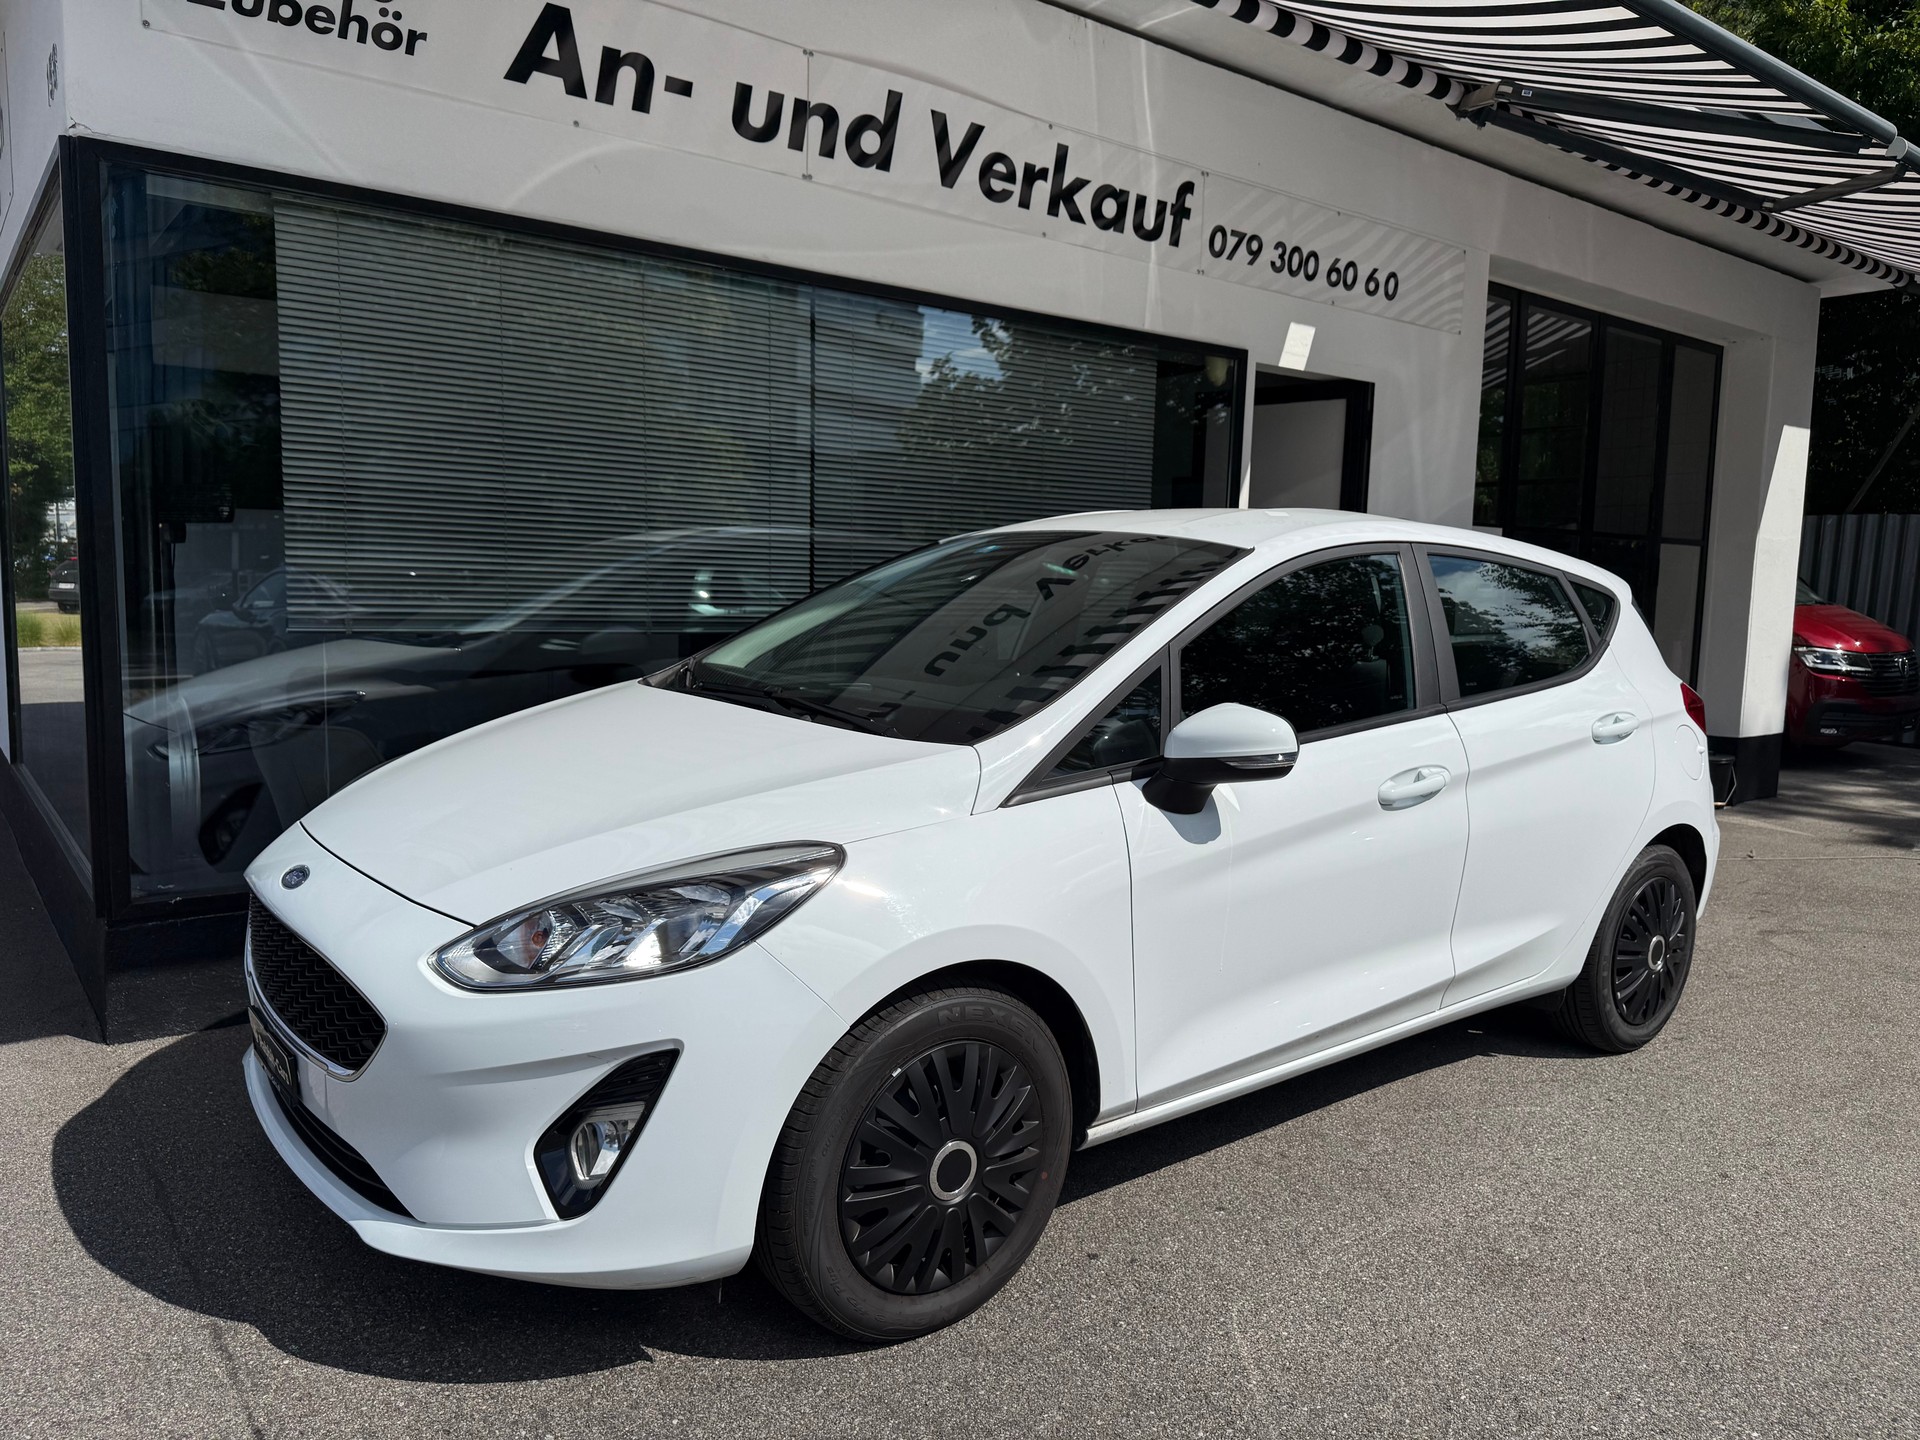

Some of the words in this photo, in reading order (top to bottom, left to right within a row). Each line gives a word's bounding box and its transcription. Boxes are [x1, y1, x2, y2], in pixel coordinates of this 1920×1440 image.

[186, 0, 428, 56] ubehör
[503, 2, 694, 114] An-
[731, 81, 903, 173] und
[929, 108, 1196, 248] Verkauf
[1208, 224, 1263, 266] 079
[1270, 241, 1320, 282] 300
[1326, 257, 1358, 292] 60
[1364, 267, 1399, 301] 60
